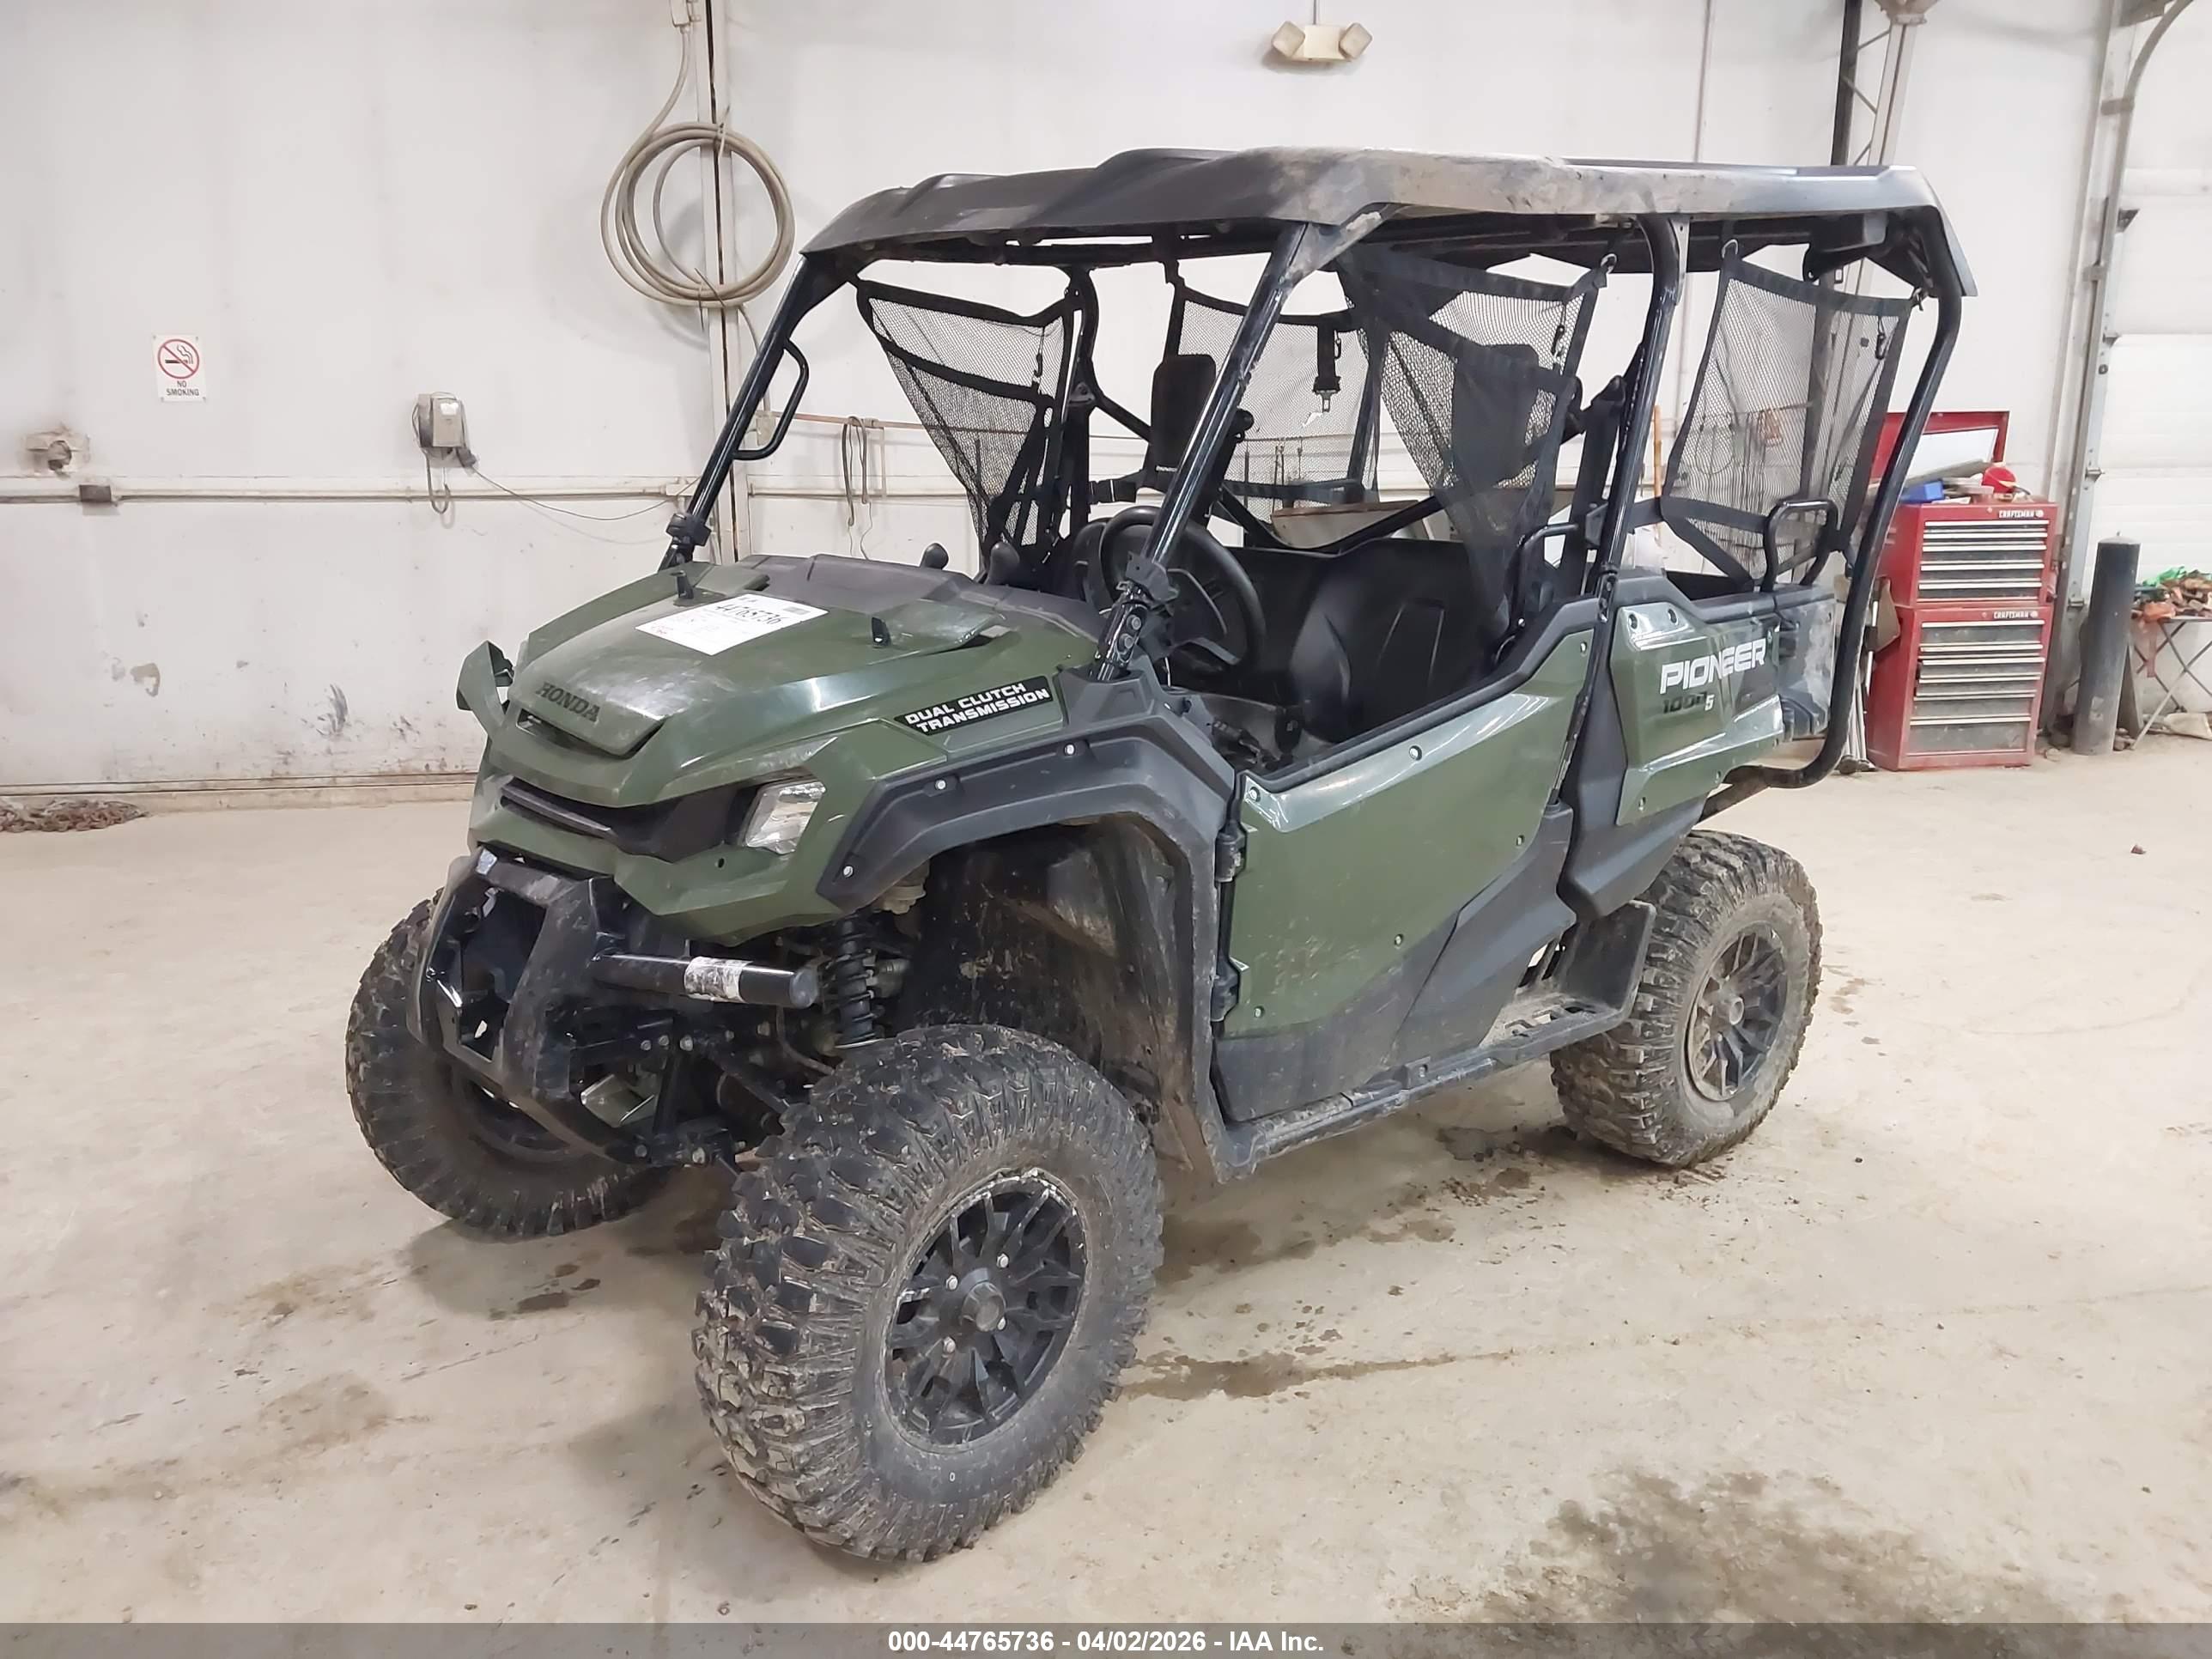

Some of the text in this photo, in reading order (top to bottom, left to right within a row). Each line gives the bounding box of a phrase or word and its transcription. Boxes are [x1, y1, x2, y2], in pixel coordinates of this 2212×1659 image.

[1660, 638, 1766, 694] PIONEER
[535, 681, 600, 722] HONDA
[905, 683, 1026, 725] DUAL CLUTCH
[916, 688, 1050, 732] TRANSMISSION
